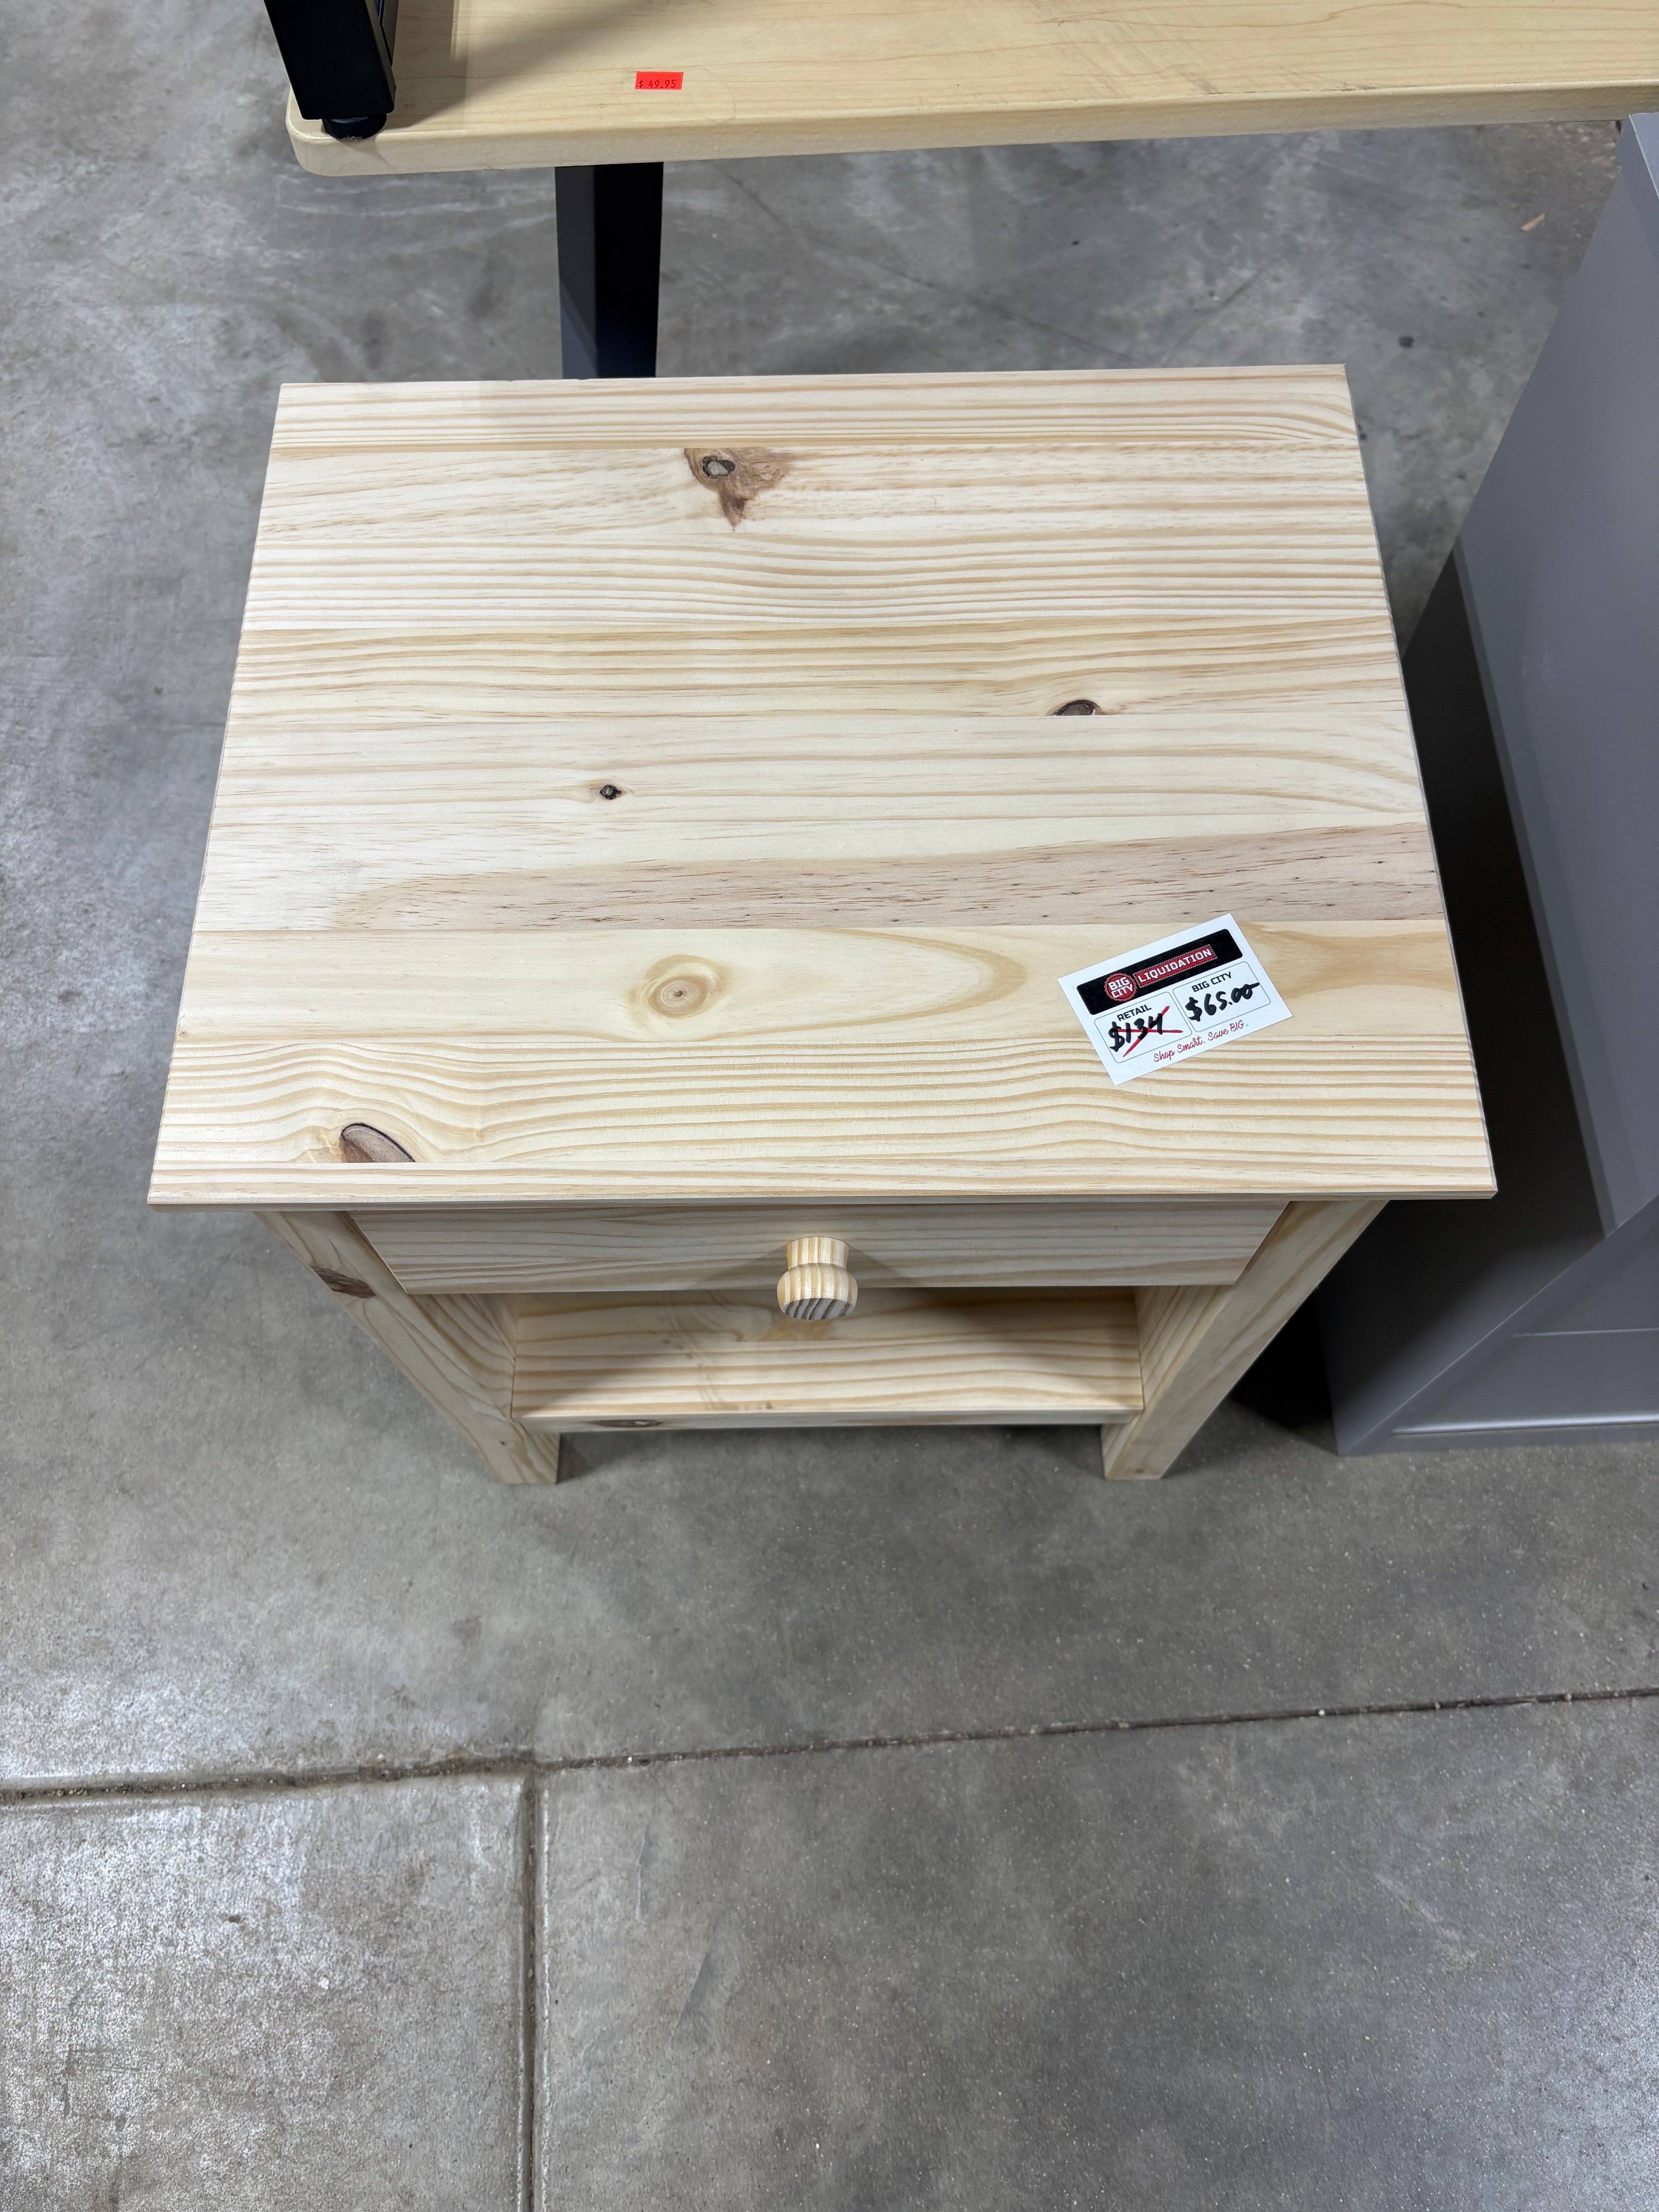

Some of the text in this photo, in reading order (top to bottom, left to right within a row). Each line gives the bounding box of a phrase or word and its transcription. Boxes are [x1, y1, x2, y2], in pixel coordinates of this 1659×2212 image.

[1137, 948, 1212, 982] LIQUIDATION
[1108, 976, 1130, 991] BIG
[1110, 983, 1134, 998] CITY
[1191, 971, 1232, 992] BIG CITY
[1116, 1004, 1152, 1021] RETAIL
[1185, 982, 1260, 1022] $65.00
[1154, 1050, 1175, 1062] Shop
[1177, 1036, 1206, 1053] Smart.
[1208, 1028, 1229, 1041] Save
